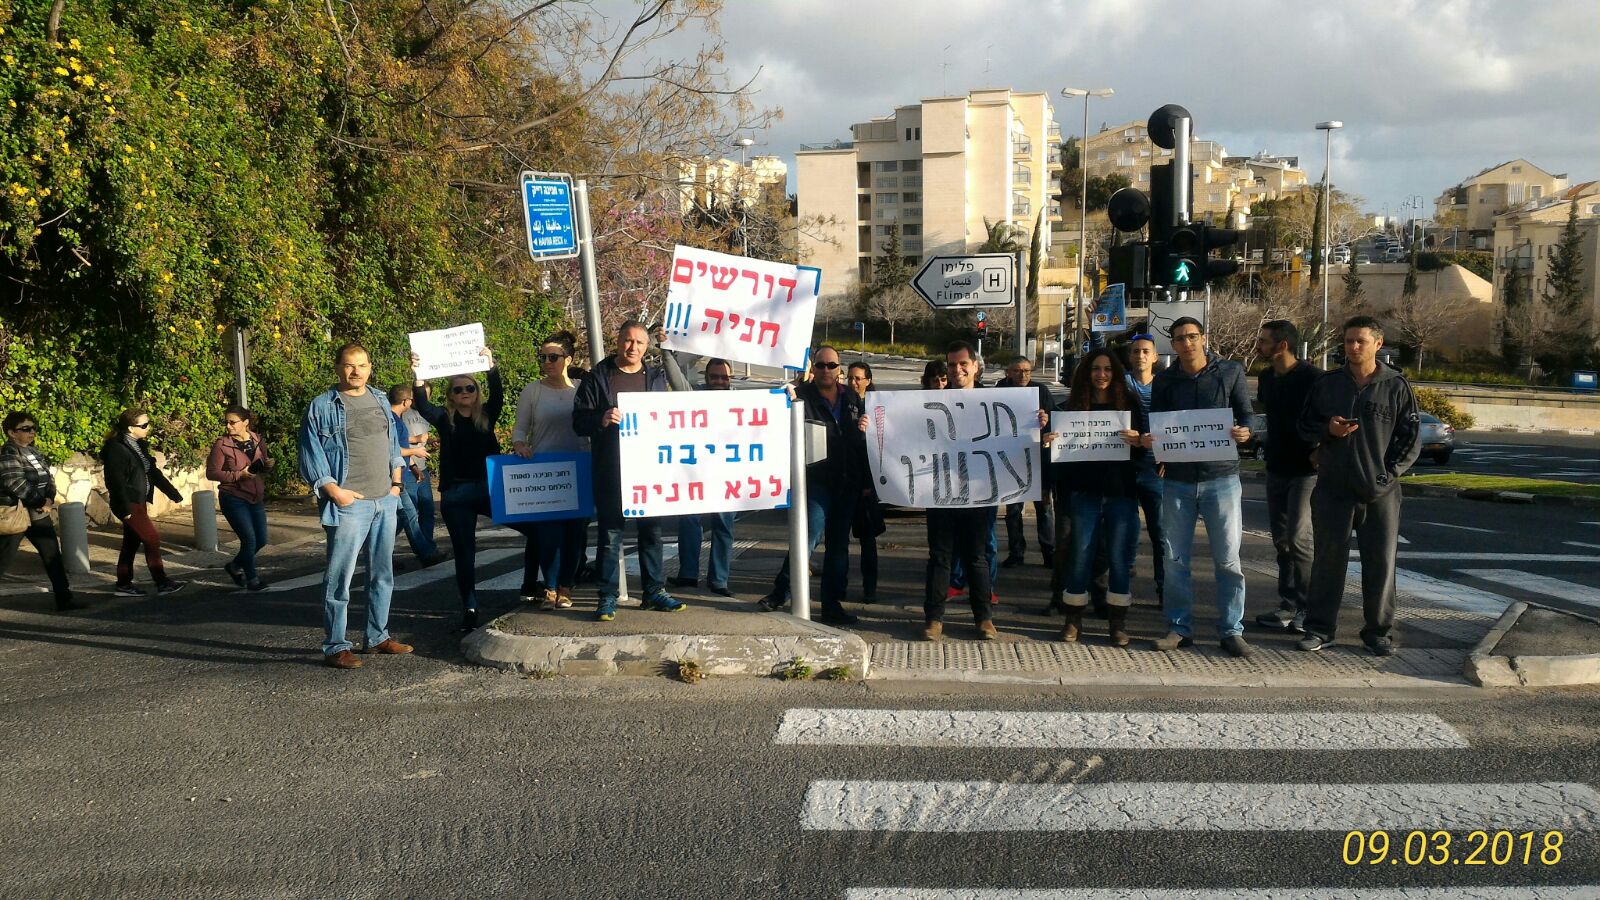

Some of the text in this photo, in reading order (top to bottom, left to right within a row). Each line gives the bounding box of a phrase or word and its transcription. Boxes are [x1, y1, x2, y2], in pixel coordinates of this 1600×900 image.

[942, 260, 974, 275] פלימן
[672, 258, 797, 302] דורשים
[990, 273, 1000, 287] H
[936, 290, 979, 300] Fliman
[700, 308, 780, 348] חניה
[650, 410, 708, 429] מתי
[728, 408, 768, 426] עד
[924, 402, 1018, 442] חניה
[1165, 423, 1224, 435] עיריית חיפה
[1162, 442, 1186, 451] תכנון
[1190, 440, 1205, 448] בלי
[658, 444, 764, 464] חביבה
[900, 448, 1032, 505] עכשיו
[632, 482, 704, 504] חניה
[724, 475, 782, 500] ללא
